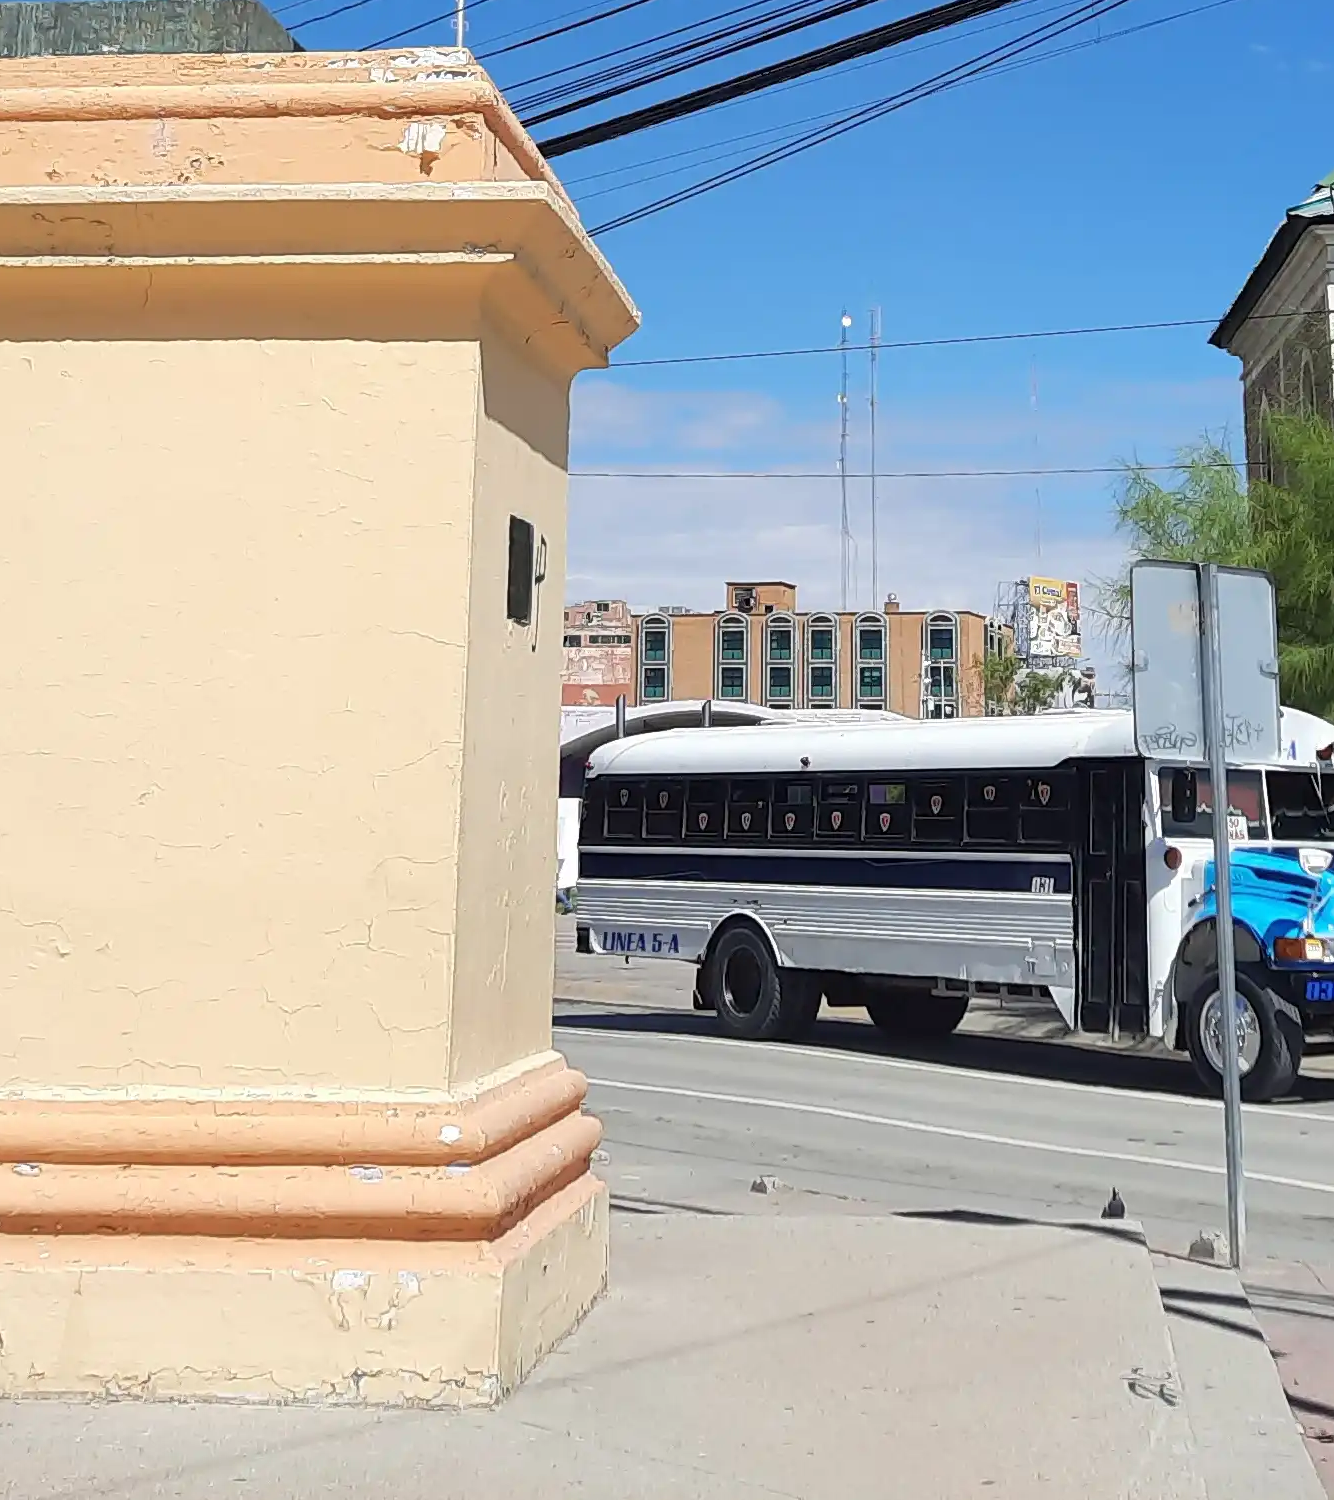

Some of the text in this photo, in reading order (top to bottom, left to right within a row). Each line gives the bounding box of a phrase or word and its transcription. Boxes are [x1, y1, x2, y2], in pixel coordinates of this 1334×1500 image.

[1031, 876, 1055, 895] 031
[602, 931, 680, 954] LINEA 5-A
